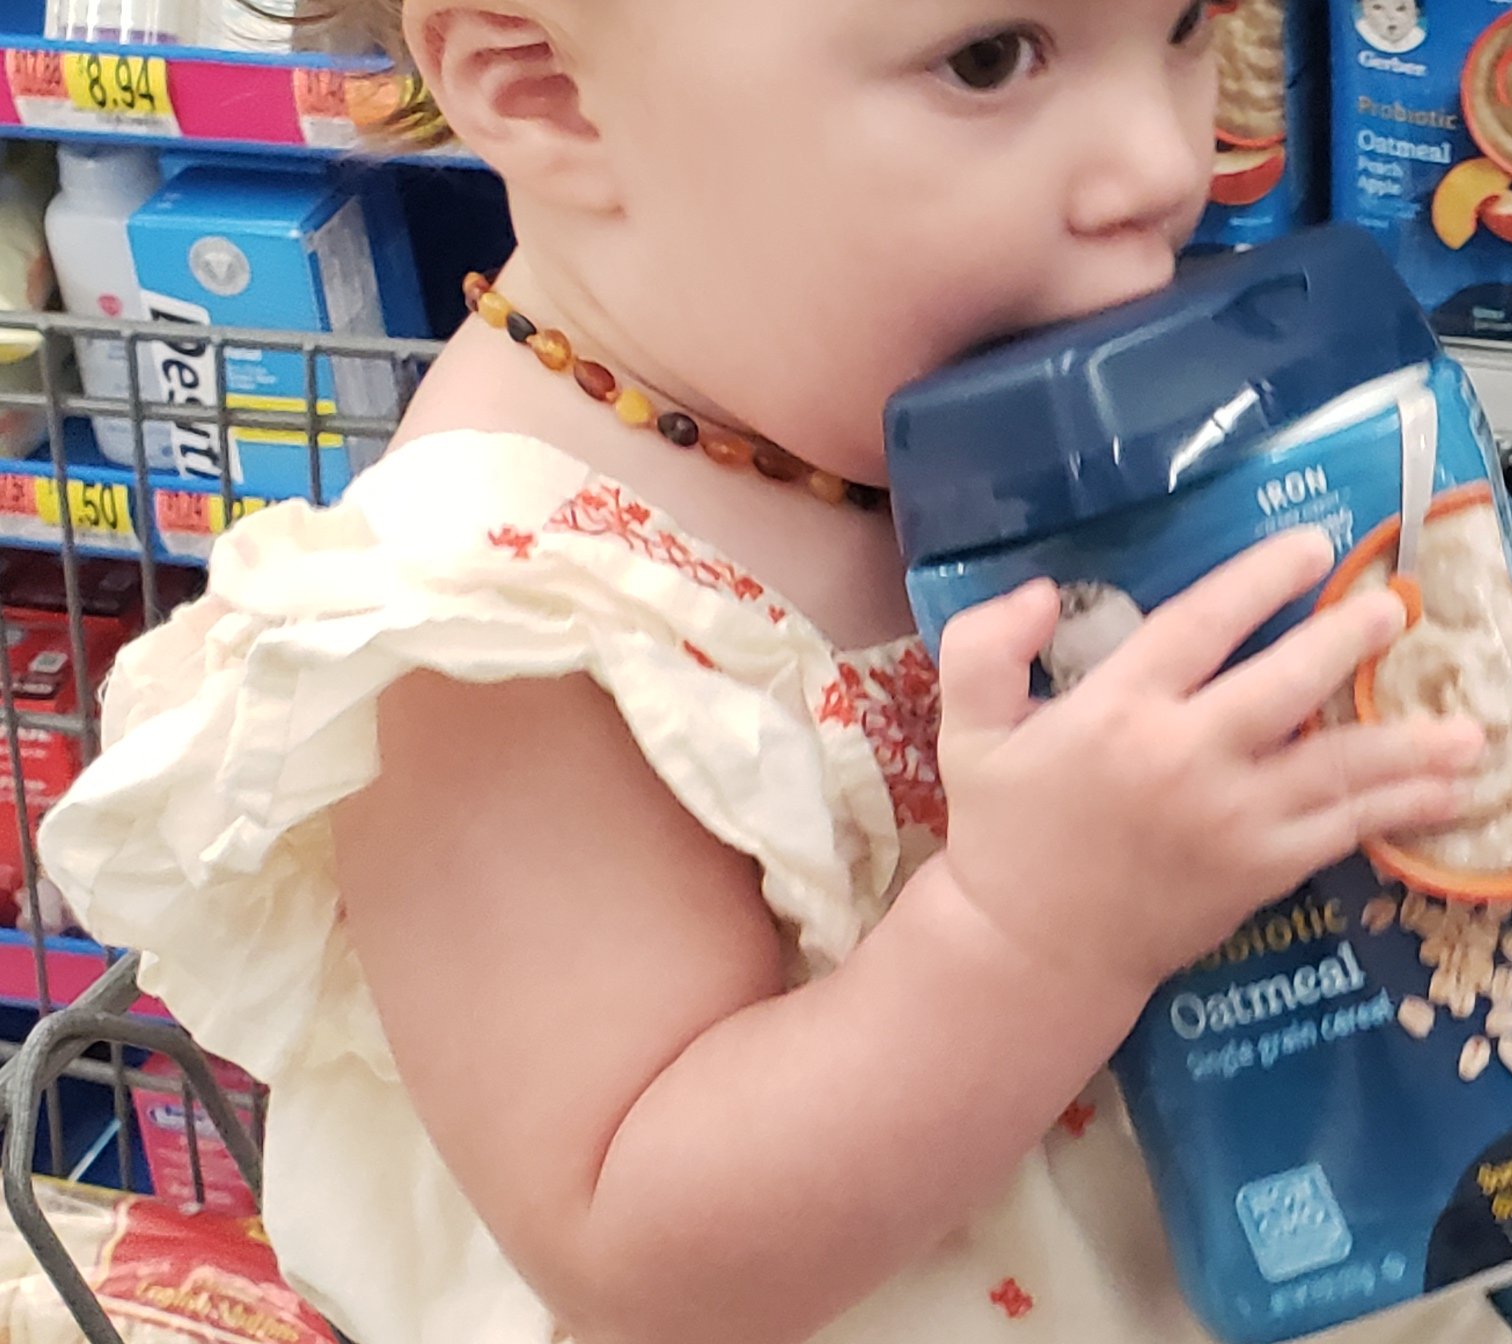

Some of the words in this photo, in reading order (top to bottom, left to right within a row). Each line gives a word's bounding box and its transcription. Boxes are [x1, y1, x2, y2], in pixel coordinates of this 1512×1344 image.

[1357, 94, 1458, 131] Probiotic
[1357, 128, 1452, 164] Oatmeal
[1257, 463, 1327, 517] IRON
[1170, 939, 1366, 1040] Oatmeal
